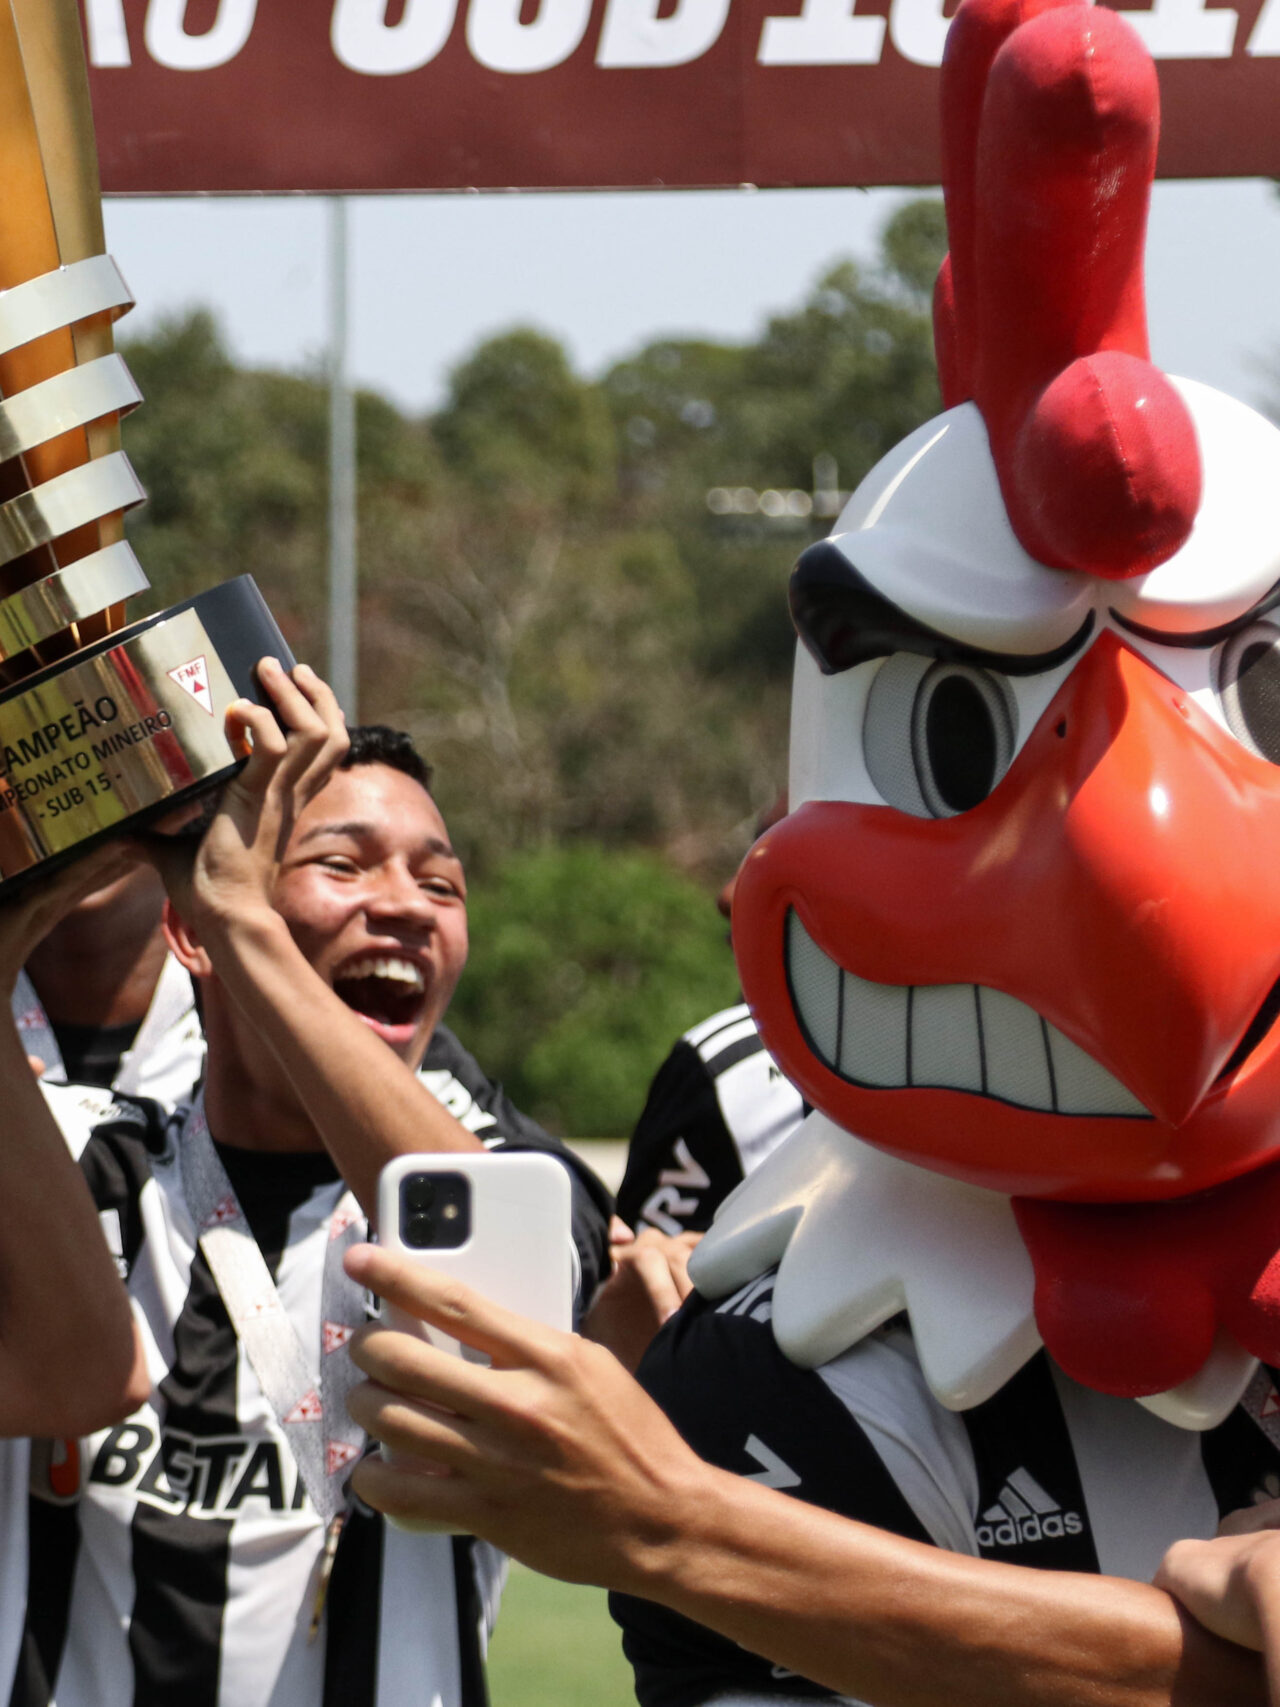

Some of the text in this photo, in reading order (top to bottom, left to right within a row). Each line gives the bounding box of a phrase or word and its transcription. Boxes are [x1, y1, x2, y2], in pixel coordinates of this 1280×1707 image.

[177, 660, 202, 683] FMF
[91, 710, 172, 762] MINEIRO
[46, 786, 85, 818] SUB
[86, 772, 113, 797] 15
[636, 1138, 711, 1236] RV
[89, 1423, 308, 1512] BETA
[976, 1511, 1083, 1547] adidas
